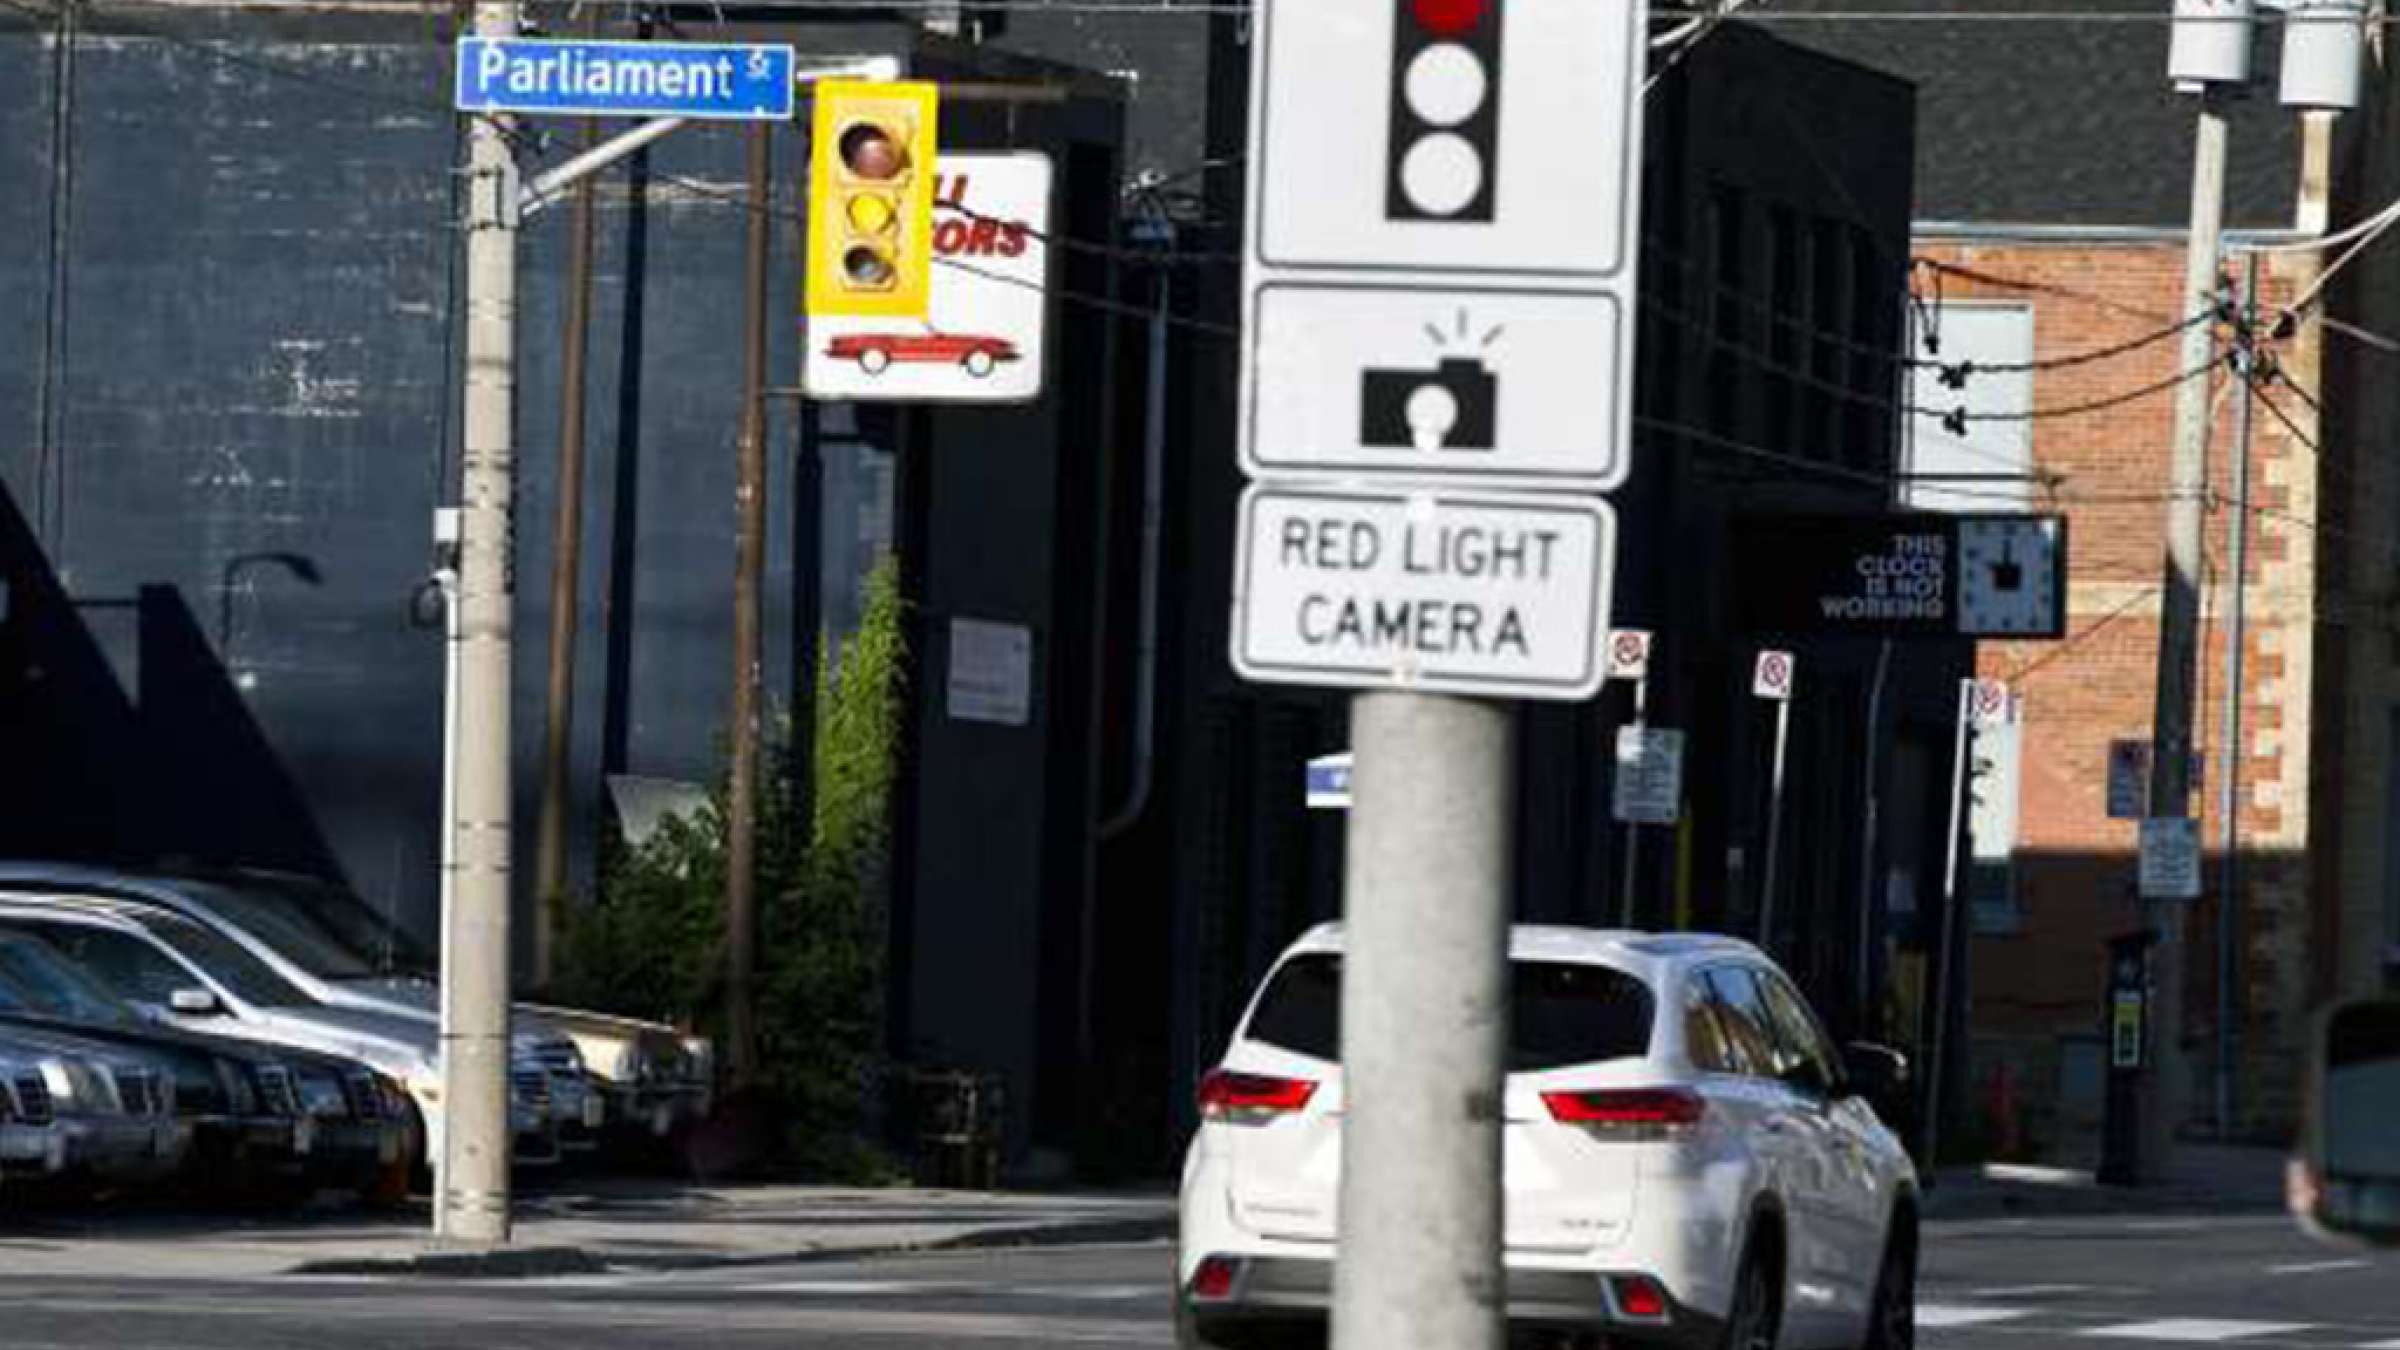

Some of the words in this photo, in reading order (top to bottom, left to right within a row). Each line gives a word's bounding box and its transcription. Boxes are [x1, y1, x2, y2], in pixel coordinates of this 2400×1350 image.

[479, 47, 733, 99] Parliament
[931, 215, 1030, 257] ORS
[1280, 516, 1379, 571] RED
[1402, 523, 1559, 579] LIGHT
[1892, 535, 1945, 555] THIS
[1856, 555, 1943, 576] CLOCK
[1866, 577, 1888, 595] IS
[1895, 577, 1943, 598] NOT
[1819, 597, 1943, 618] WORKING
[1298, 594, 1530, 656] CAMERA
